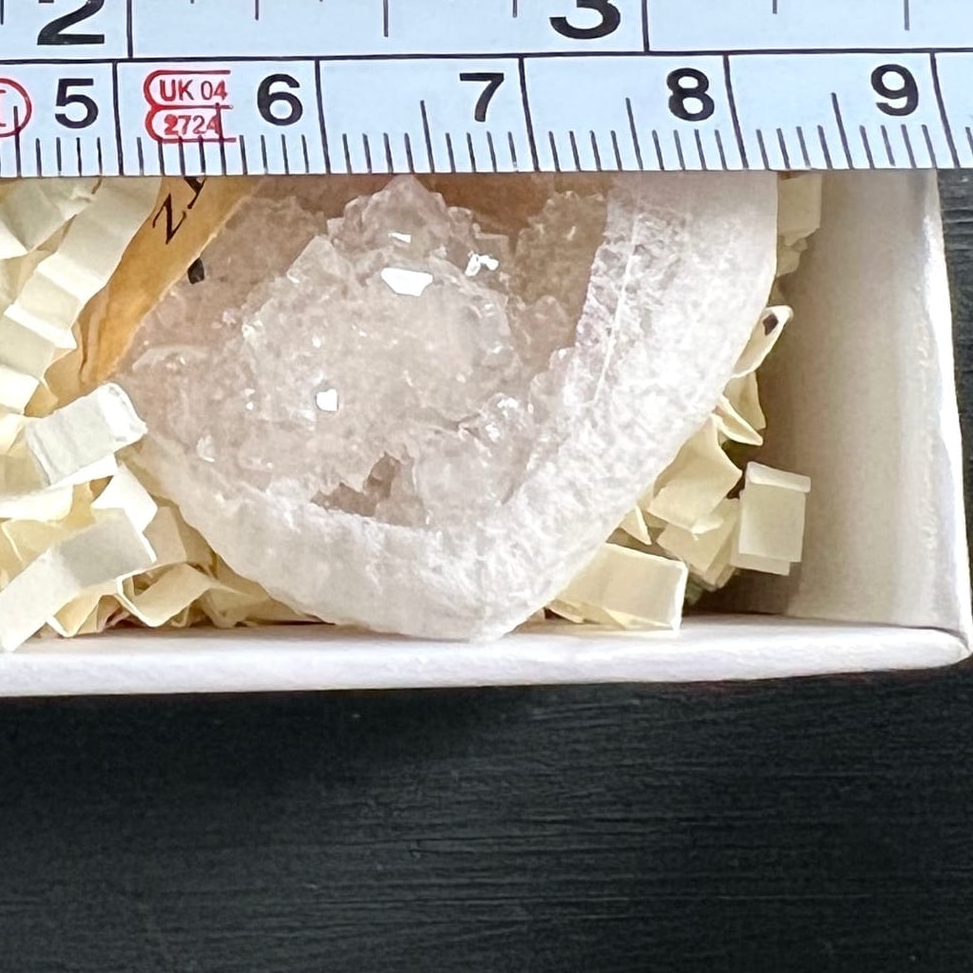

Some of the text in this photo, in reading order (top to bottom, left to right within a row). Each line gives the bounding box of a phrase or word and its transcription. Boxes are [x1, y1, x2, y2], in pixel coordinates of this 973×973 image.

[54, 78, 99, 129] 5
[159, 79, 228, 102] UK 04
[256, 74, 304, 126] 6
[459, 72, 505, 123] 7
[666, 68, 715, 121] 8
[870, 64, 920, 117] 9
